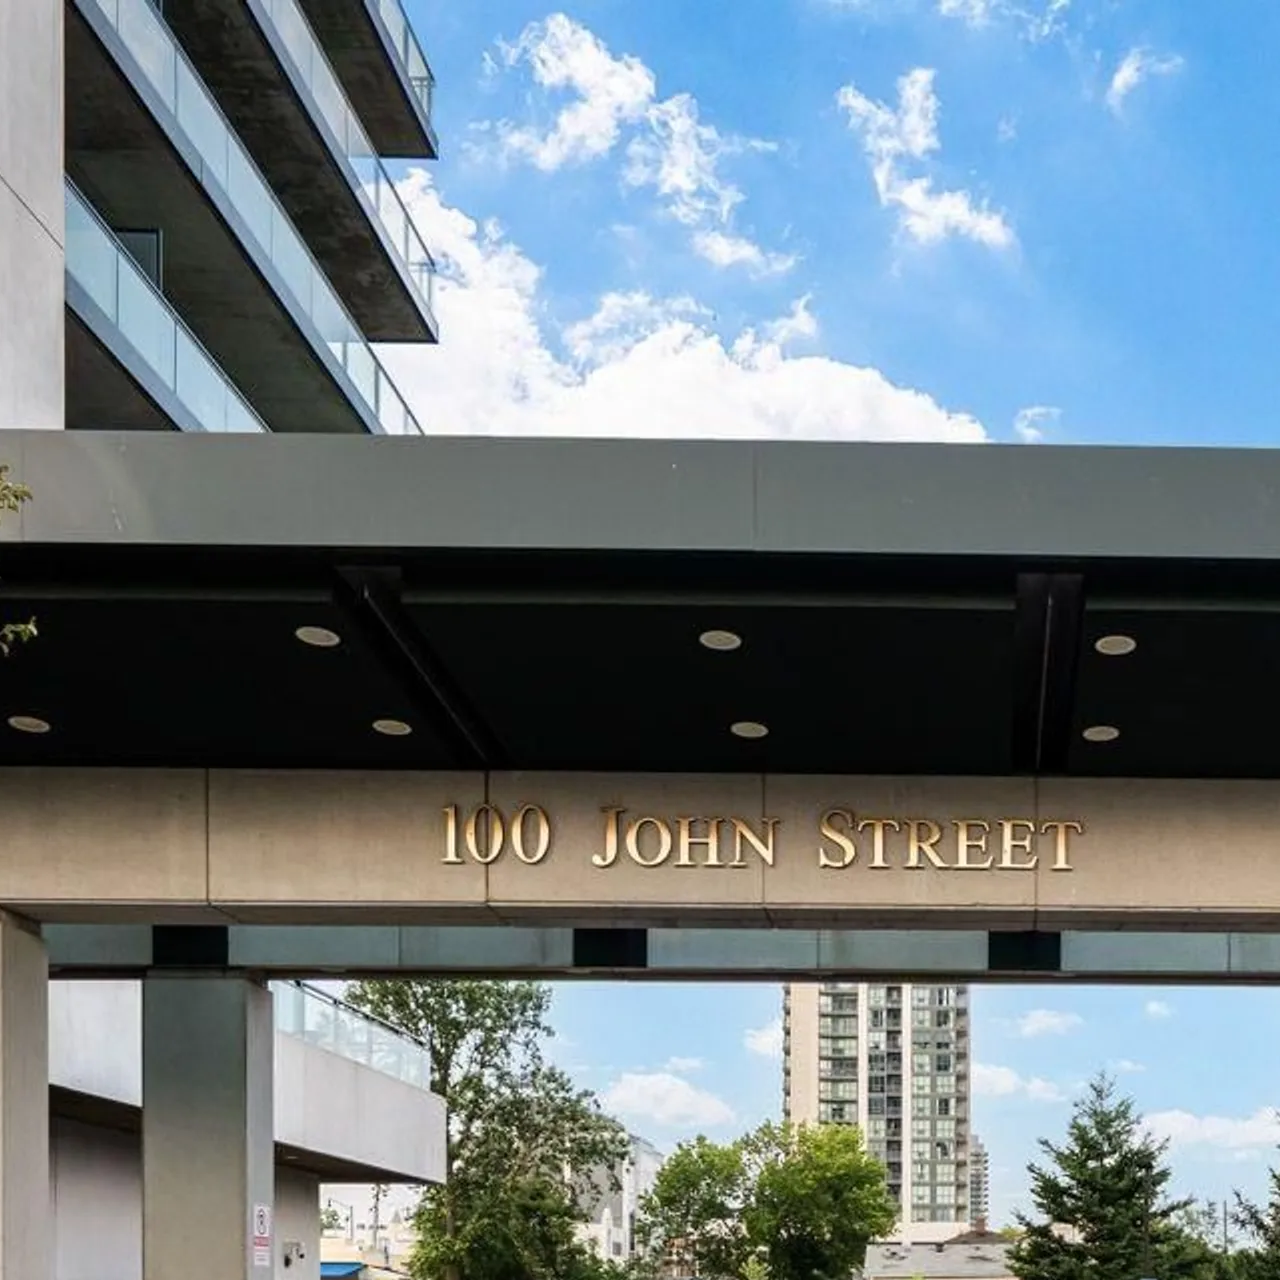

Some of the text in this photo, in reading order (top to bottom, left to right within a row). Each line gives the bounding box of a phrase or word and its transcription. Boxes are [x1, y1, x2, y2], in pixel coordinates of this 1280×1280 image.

[440, 803, 1084, 871] 100 JOHN STREET
